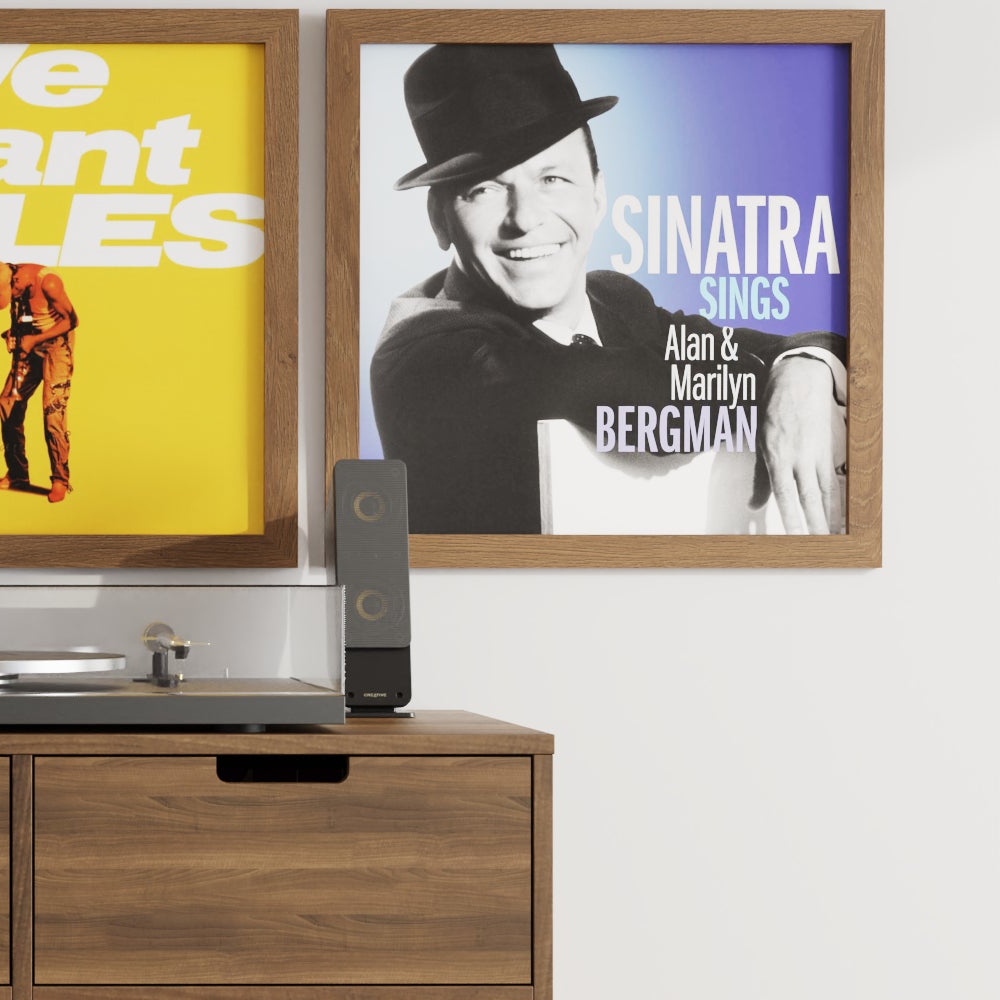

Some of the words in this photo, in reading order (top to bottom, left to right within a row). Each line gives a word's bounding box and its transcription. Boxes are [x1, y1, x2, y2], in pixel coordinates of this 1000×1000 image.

[610, 195, 841, 275] SINATRA
[699, 275, 790, 320] SINGS
[664, 325, 715, 361] Alan
[720, 326, 739, 361] &
[671, 364, 757, 410] Marilyn
[595, 405, 758, 453] BERGMAN
